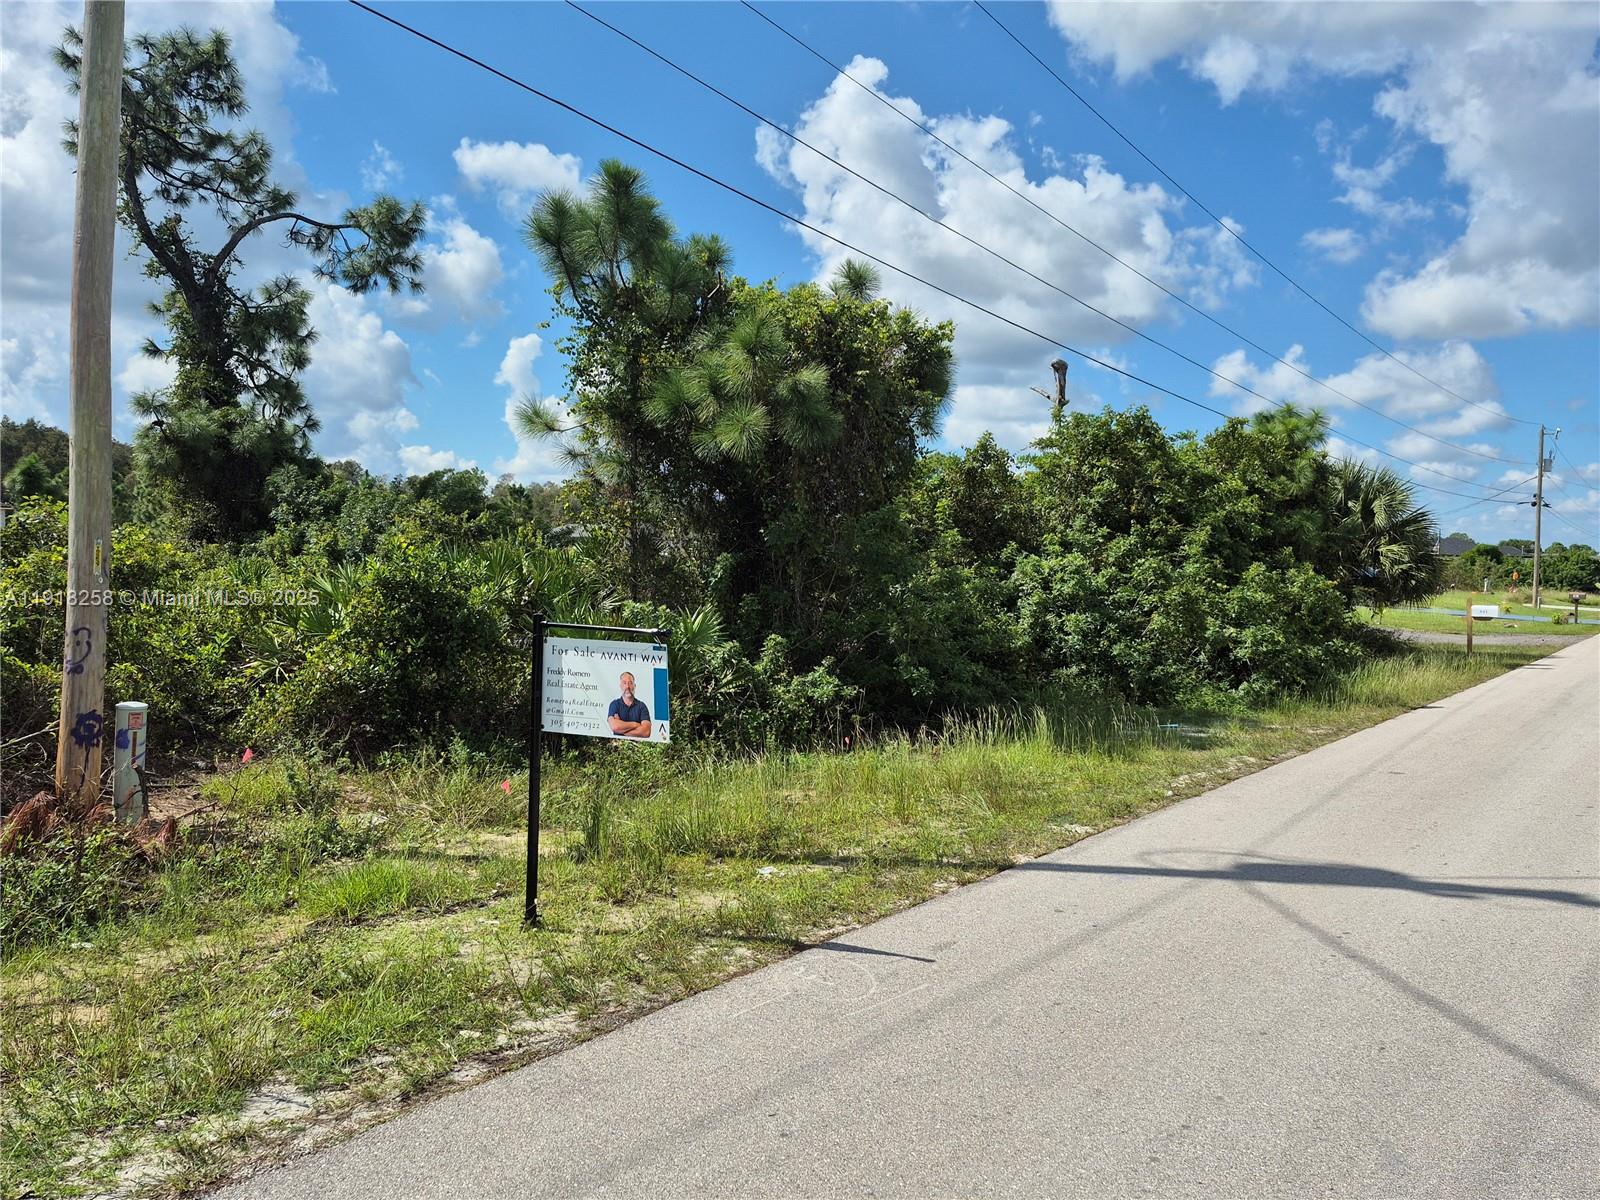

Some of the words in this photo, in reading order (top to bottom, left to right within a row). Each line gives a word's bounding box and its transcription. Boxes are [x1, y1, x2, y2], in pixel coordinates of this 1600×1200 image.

[551, 644, 569, 656] For
[573, 646, 596, 658] Sale
[600, 651, 637, 662] AVANTI
[641, 653, 664, 664] WAY
[546, 667, 566, 677] Freddy
[567, 668, 591, 678] Romero
[546, 679, 560, 688] Real
[560, 681, 579, 689] Estate
[579, 682, 598, 692] Agent
[550, 718, 601, 730] 305-407-0322
